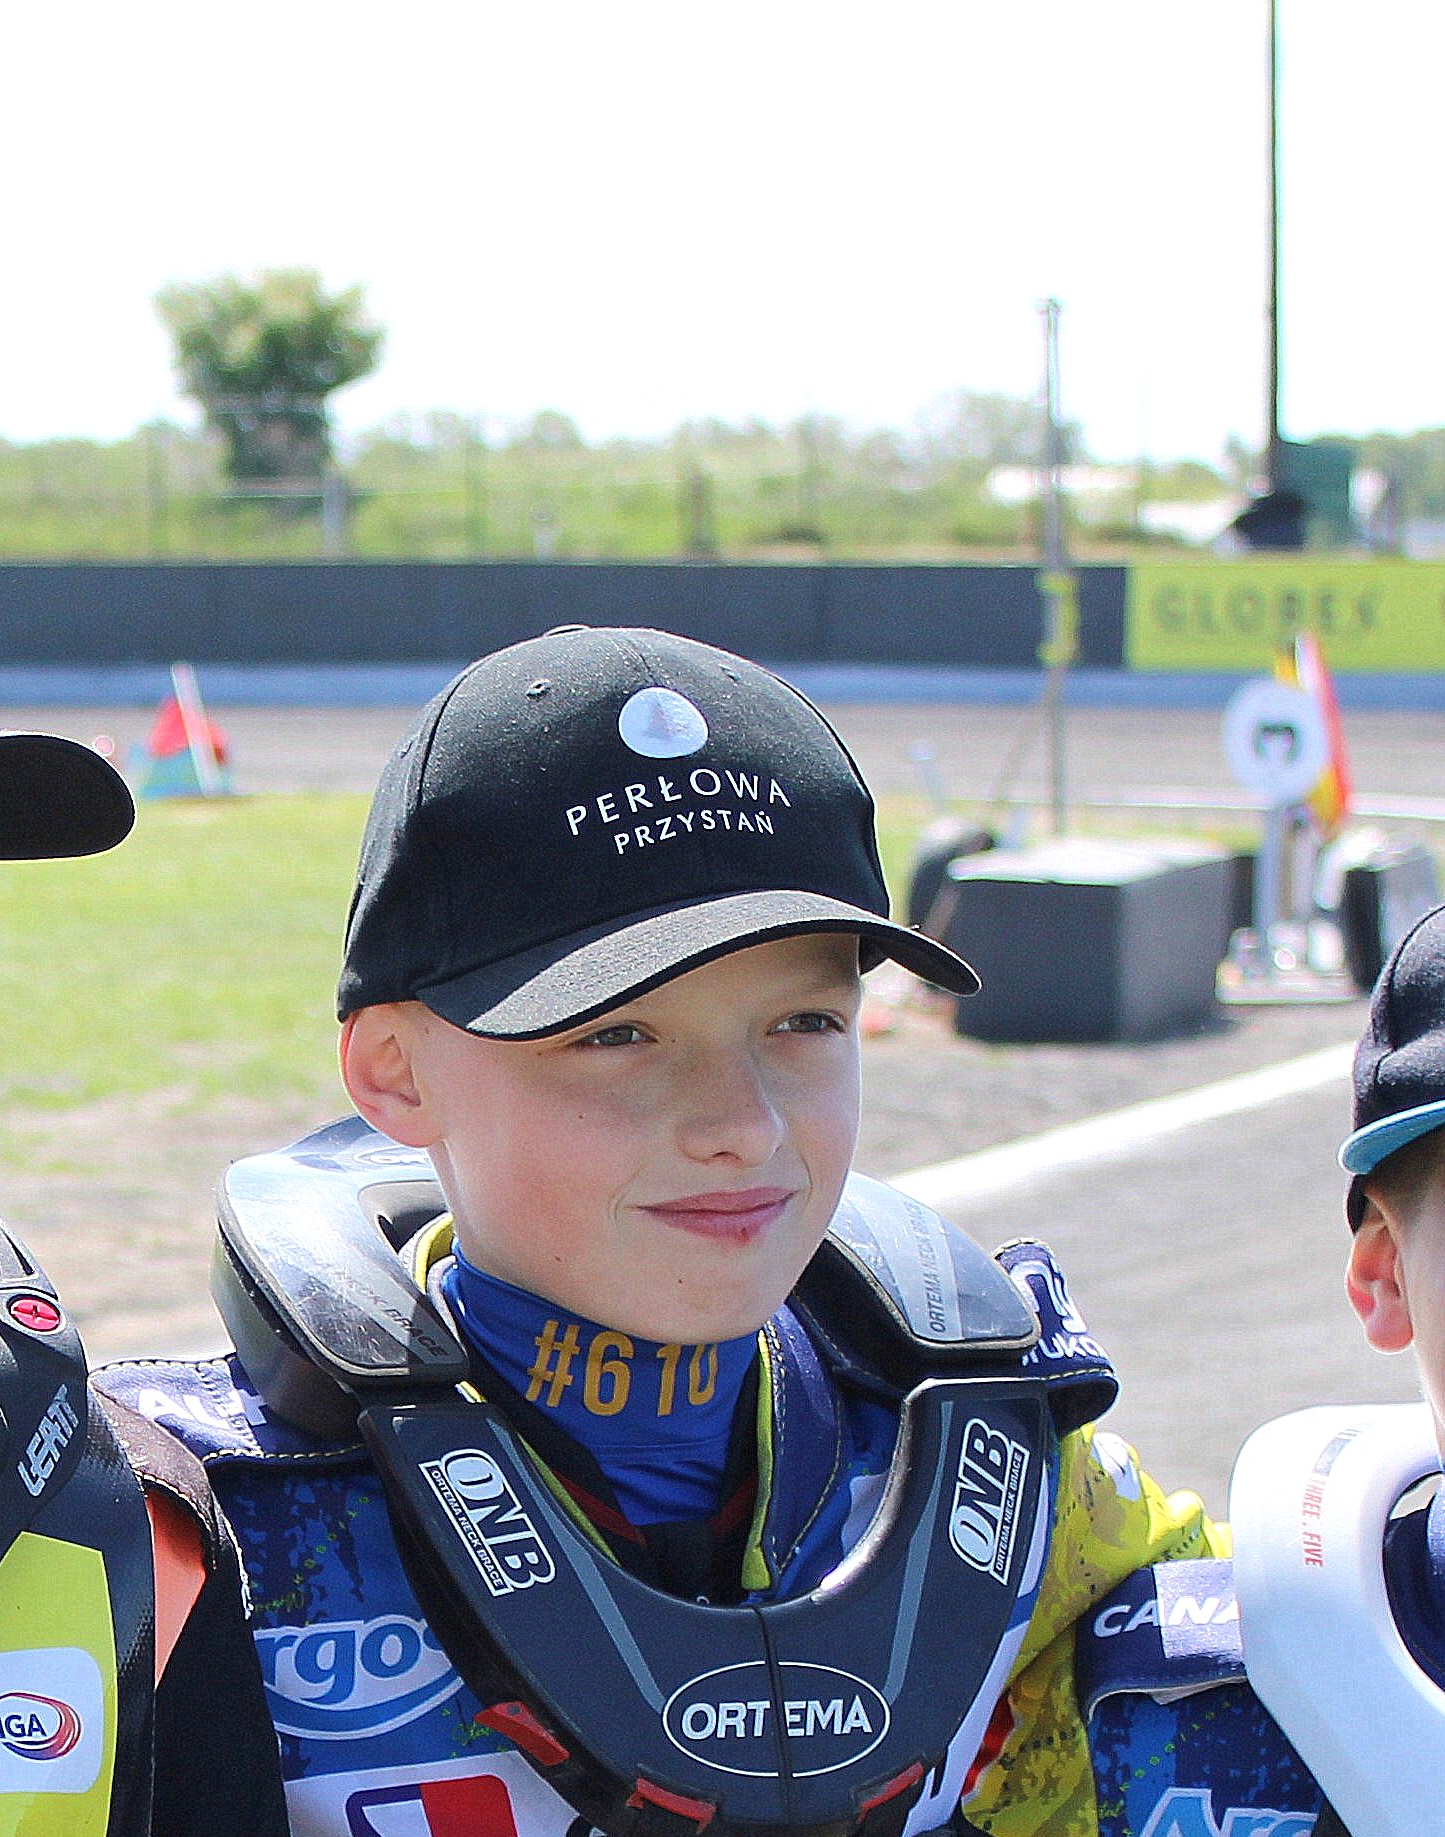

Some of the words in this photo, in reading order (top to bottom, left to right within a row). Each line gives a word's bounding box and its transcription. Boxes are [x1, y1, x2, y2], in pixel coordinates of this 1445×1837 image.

[566, 768, 791, 836] PERŁOWA
[614, 810, 774, 854] PRZYSTAŃ
[17, 1383, 81, 1498] LEATT
[681, 1696, 874, 1743] ORTEMA
